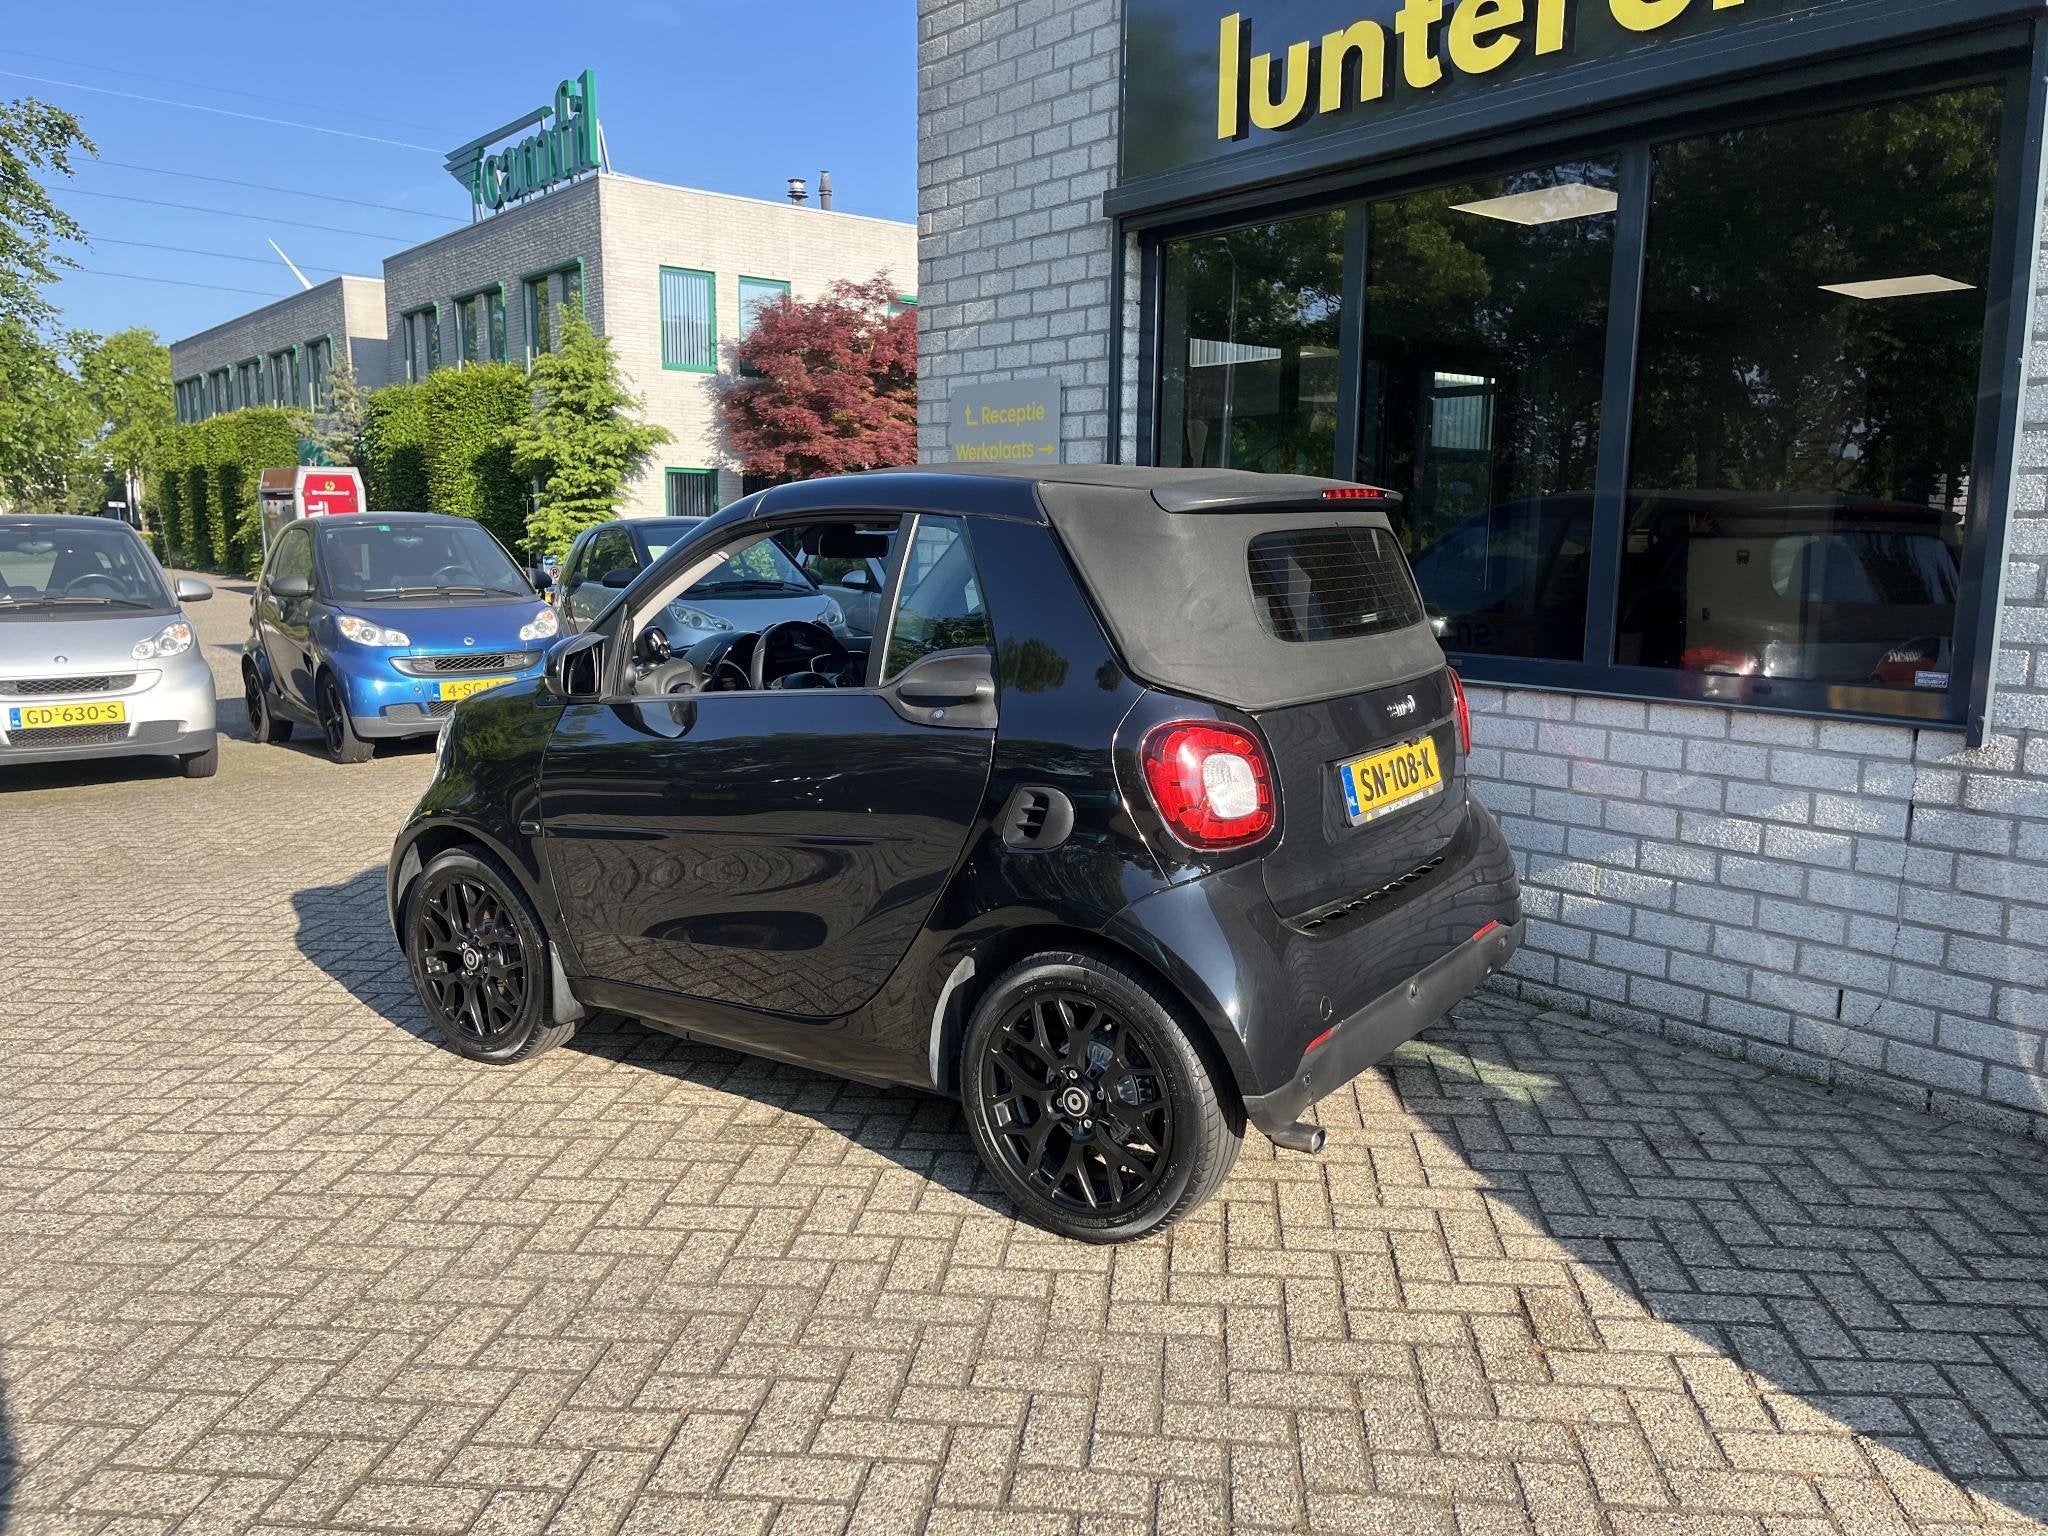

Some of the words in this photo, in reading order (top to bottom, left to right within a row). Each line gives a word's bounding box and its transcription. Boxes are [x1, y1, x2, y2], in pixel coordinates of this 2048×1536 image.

[1217, 0, 1746, 140] lunte
[981, 401, 1045, 427] Receptie
[956, 440, 1034, 462] Werkplaats
[1359, 746, 1435, 802] SN-108-K
